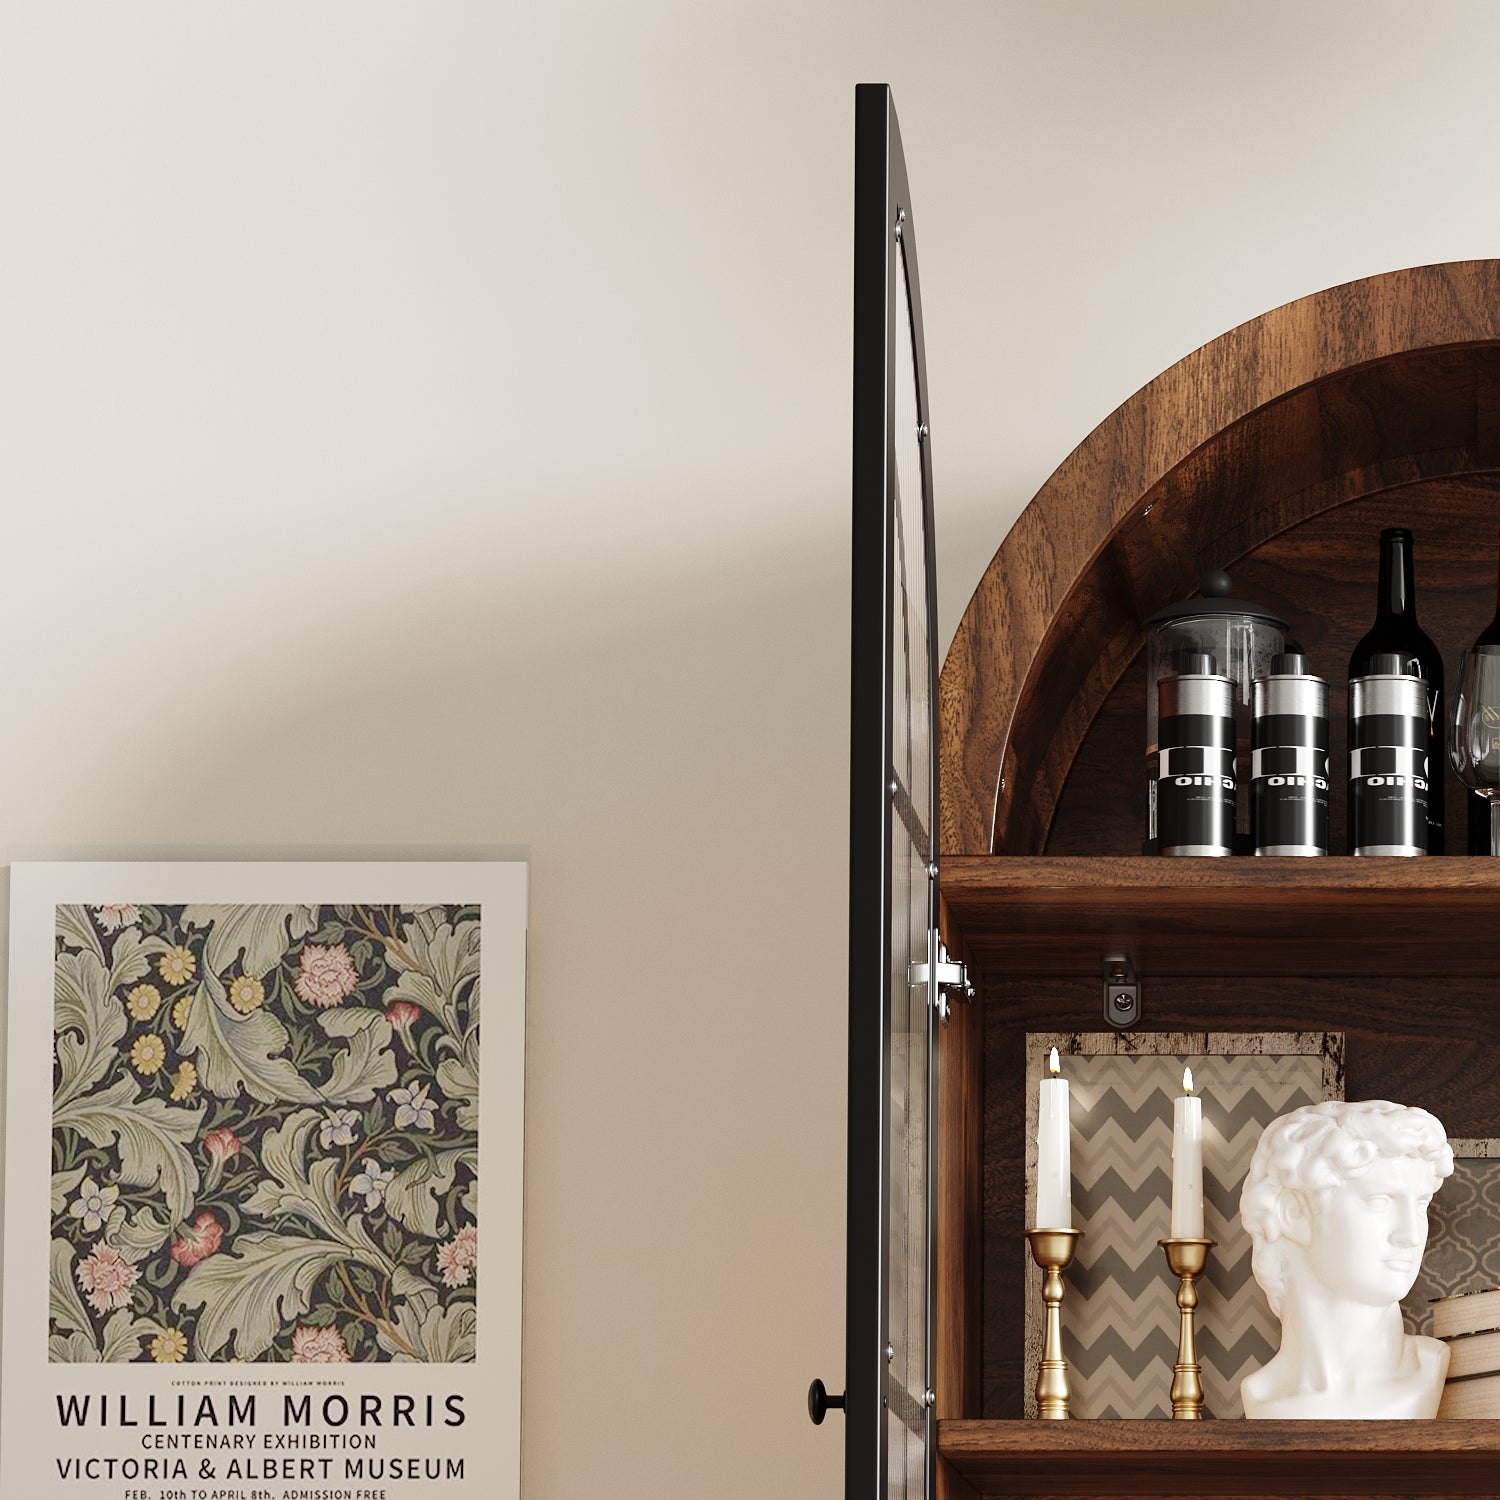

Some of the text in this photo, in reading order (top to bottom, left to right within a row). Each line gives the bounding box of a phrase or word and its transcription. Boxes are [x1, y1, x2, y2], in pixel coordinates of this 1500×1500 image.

[56, 1394, 466, 1427] WILLIAM MORRIS
[141, 1434, 376, 1450] CENTENARY EXHIBITION
[56, 1458, 465, 1480] VICTORIA & ALBERT MUSEUM
[125, 1489, 386, 1500] FEB. 10th TO APRIL 8th. ADMISSION FREE
